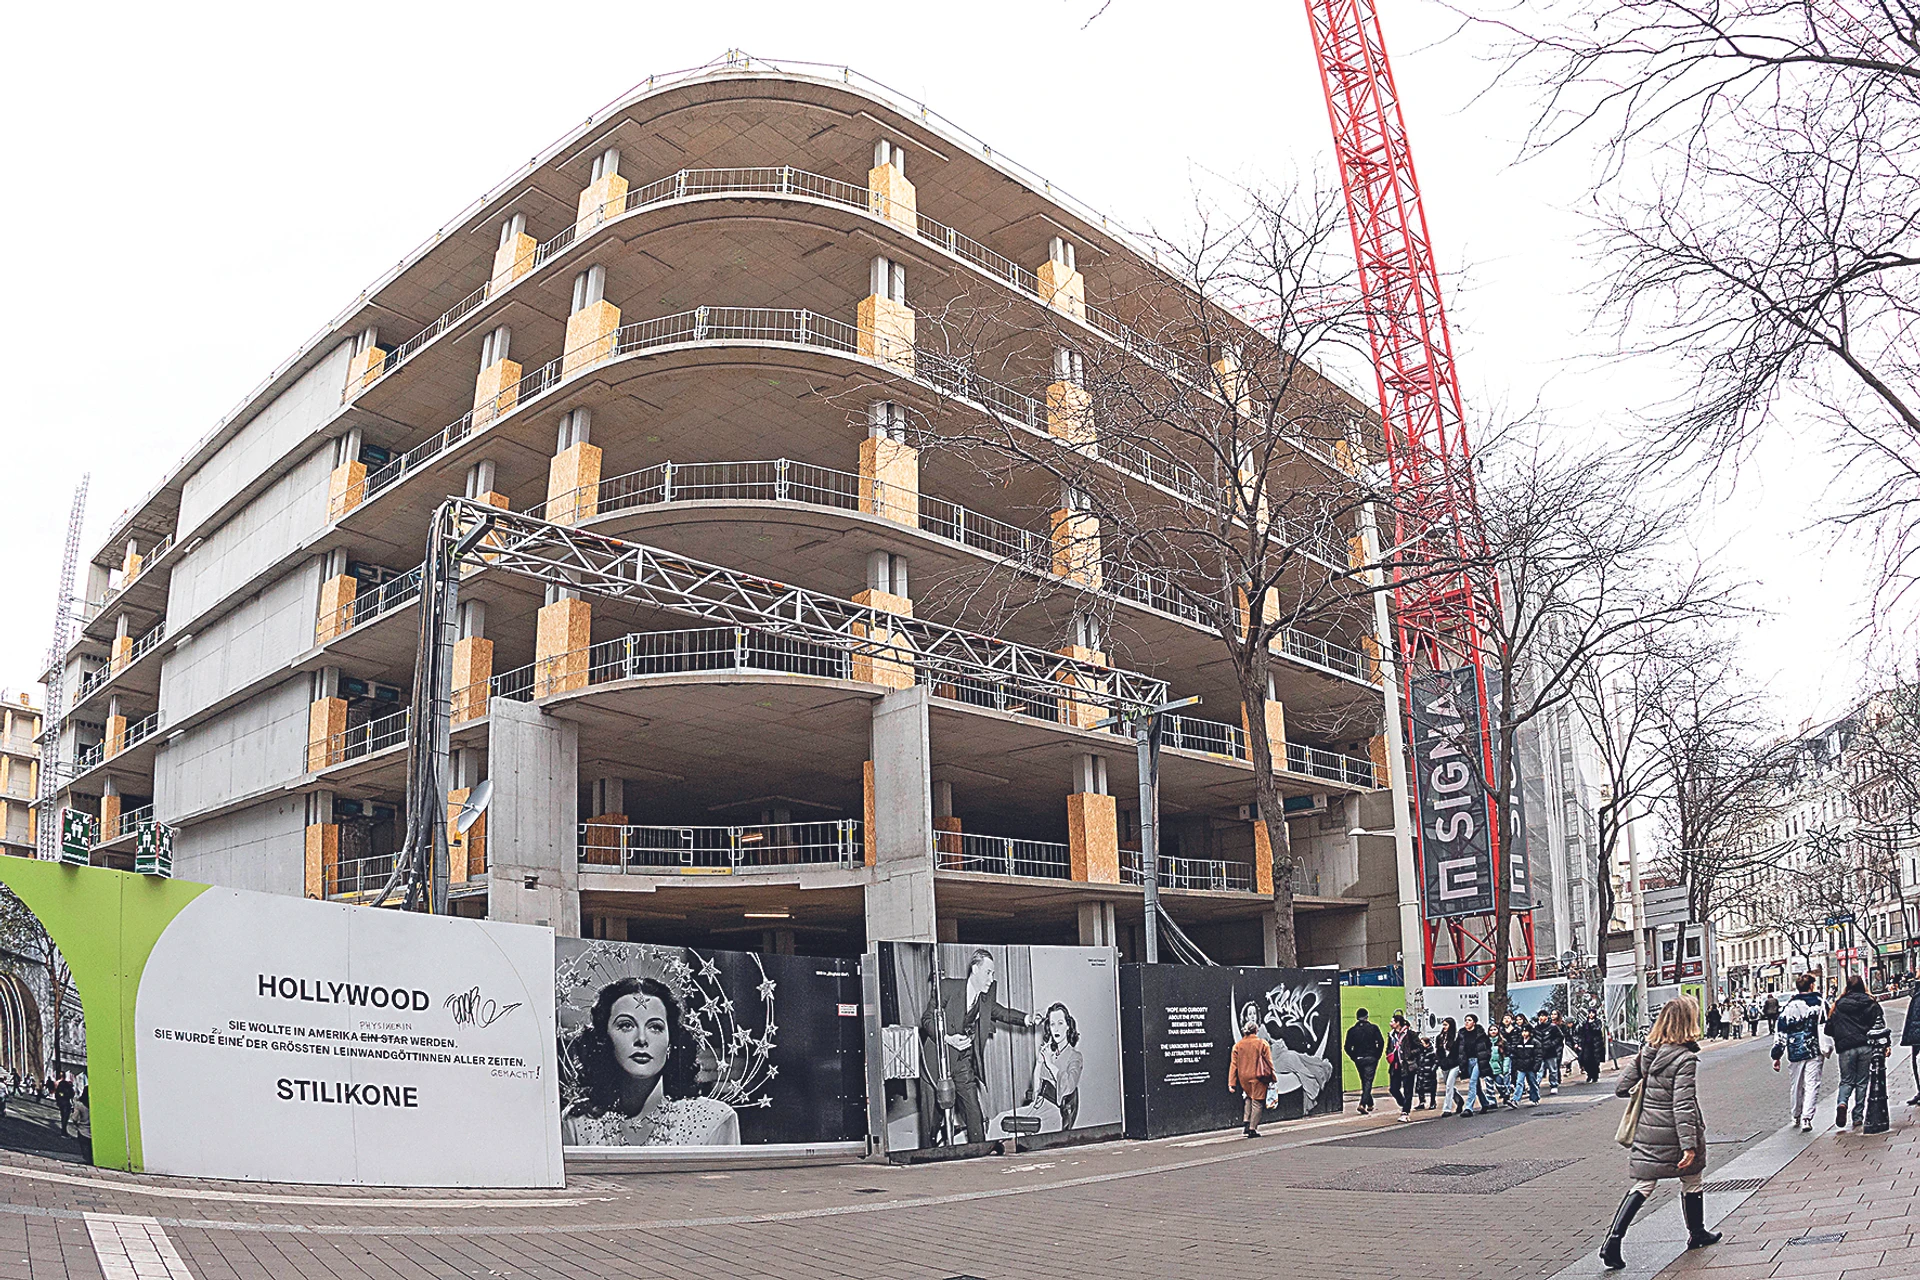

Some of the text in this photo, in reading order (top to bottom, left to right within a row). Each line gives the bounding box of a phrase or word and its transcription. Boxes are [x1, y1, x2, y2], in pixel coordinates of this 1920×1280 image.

[1425, 683, 1474, 843] SIGNA
[258, 974, 430, 1011] HOLLYWOOD
[228, 1020, 458, 1048] SIE WOLLTE IN AMERIKA EIN STAR WERDEN.
[359, 1021, 412, 1030] PHYSIKERIN
[154, 1028, 172, 1040] SIE
[174, 1031, 215, 1045] WURDE
[246, 1039, 268, 1050] DER
[271, 1041, 330, 1055] GRÖSSTEN
[333, 1046, 451, 1063] LEINWANDGÖTTINNEN
[453, 1055, 486, 1066] ALLER
[487, 1056, 526, 1067] ZEITEN.
[276, 1078, 419, 1107] STILIKONE
